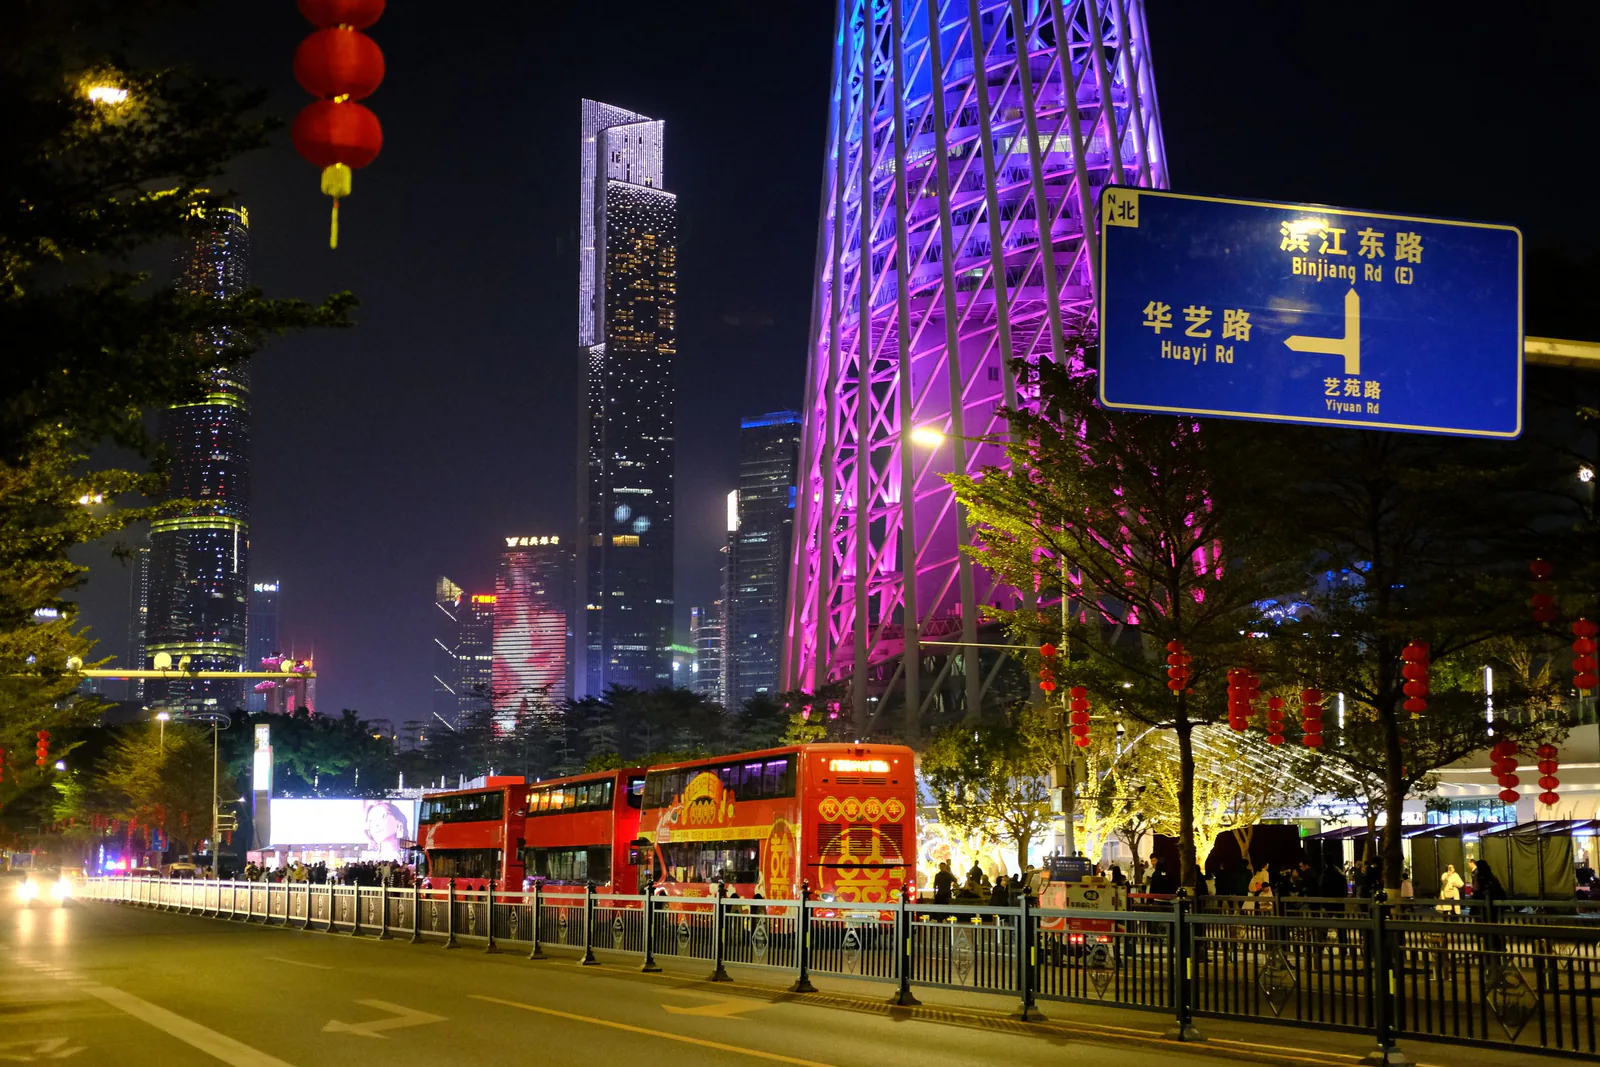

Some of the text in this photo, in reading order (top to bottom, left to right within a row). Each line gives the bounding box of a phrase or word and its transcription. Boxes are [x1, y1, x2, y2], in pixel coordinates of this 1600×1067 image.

[1107, 194, 1116, 205] N
[1118, 200, 1136, 220] 北
[1279, 219, 1425, 265] 滨江东路
[1292, 256, 1414, 286] Binjiang Rd (E)
[1142, 300, 1253, 342] 华艺路
[1161, 340, 1234, 366] Huayi Rd
[1323, 377, 1382, 400] 艺苑路
[1325, 398, 1380, 415] Yiyuan Rd
